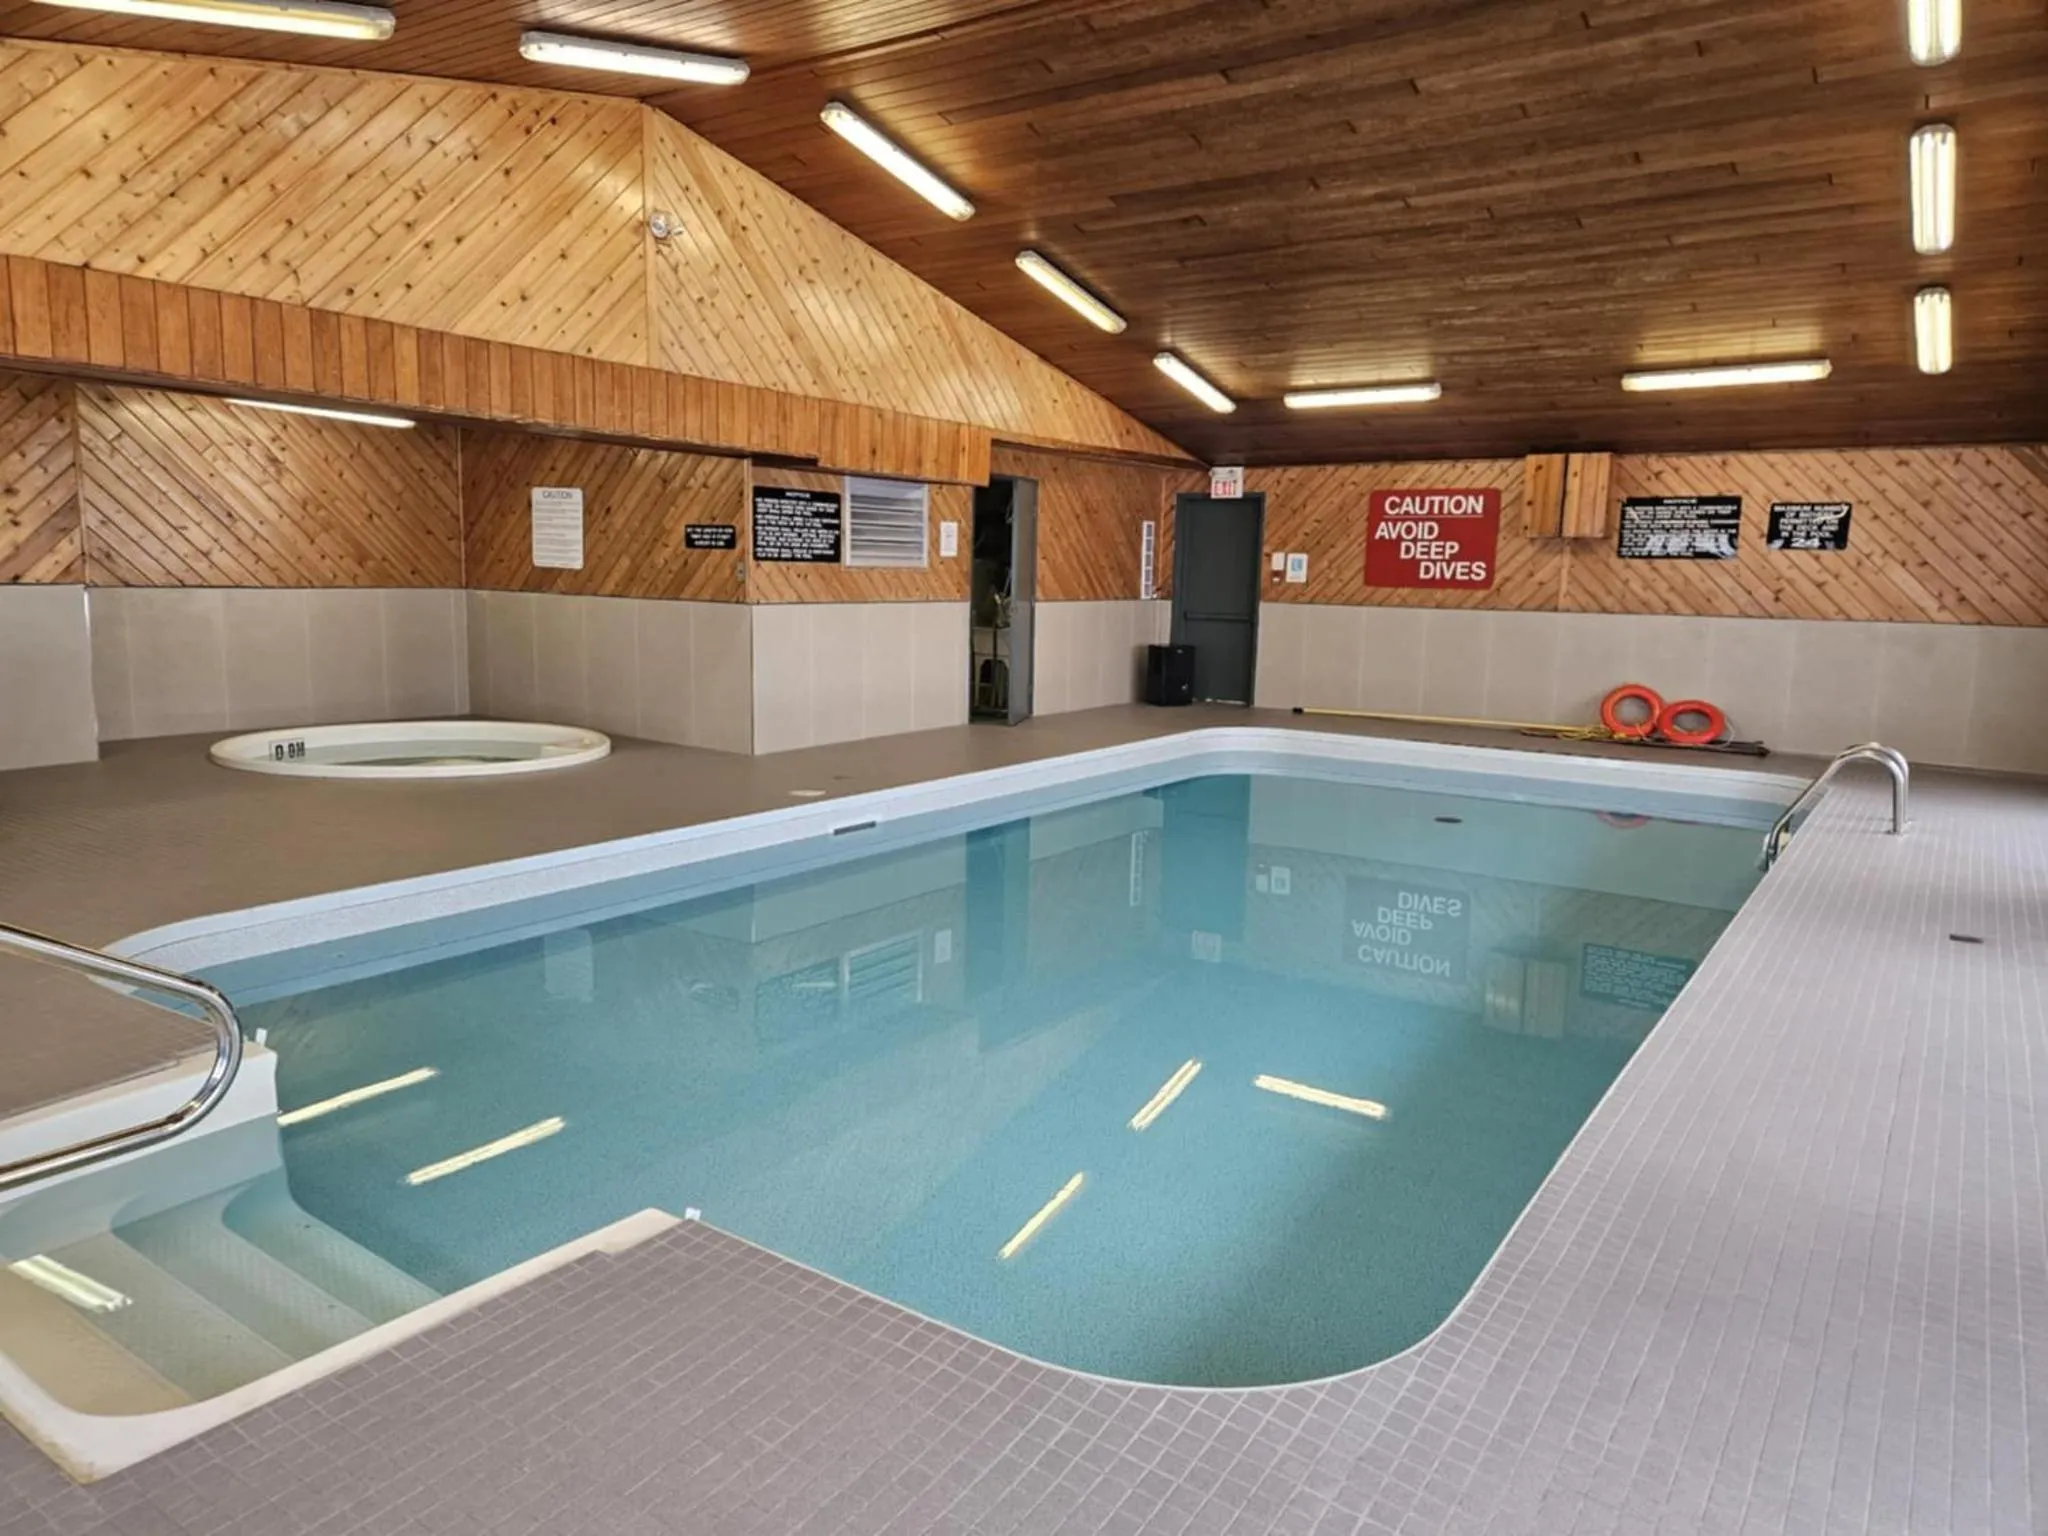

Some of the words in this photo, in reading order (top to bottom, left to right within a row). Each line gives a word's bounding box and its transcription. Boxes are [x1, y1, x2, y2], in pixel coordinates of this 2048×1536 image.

[1214, 480, 1238, 496] EXIT
[1384, 495, 1484, 515] CAUTION
[1374, 521, 1440, 540] AVOID
[1400, 541, 1460, 560] DEEP
[1419, 561, 1487, 582] DIVES
